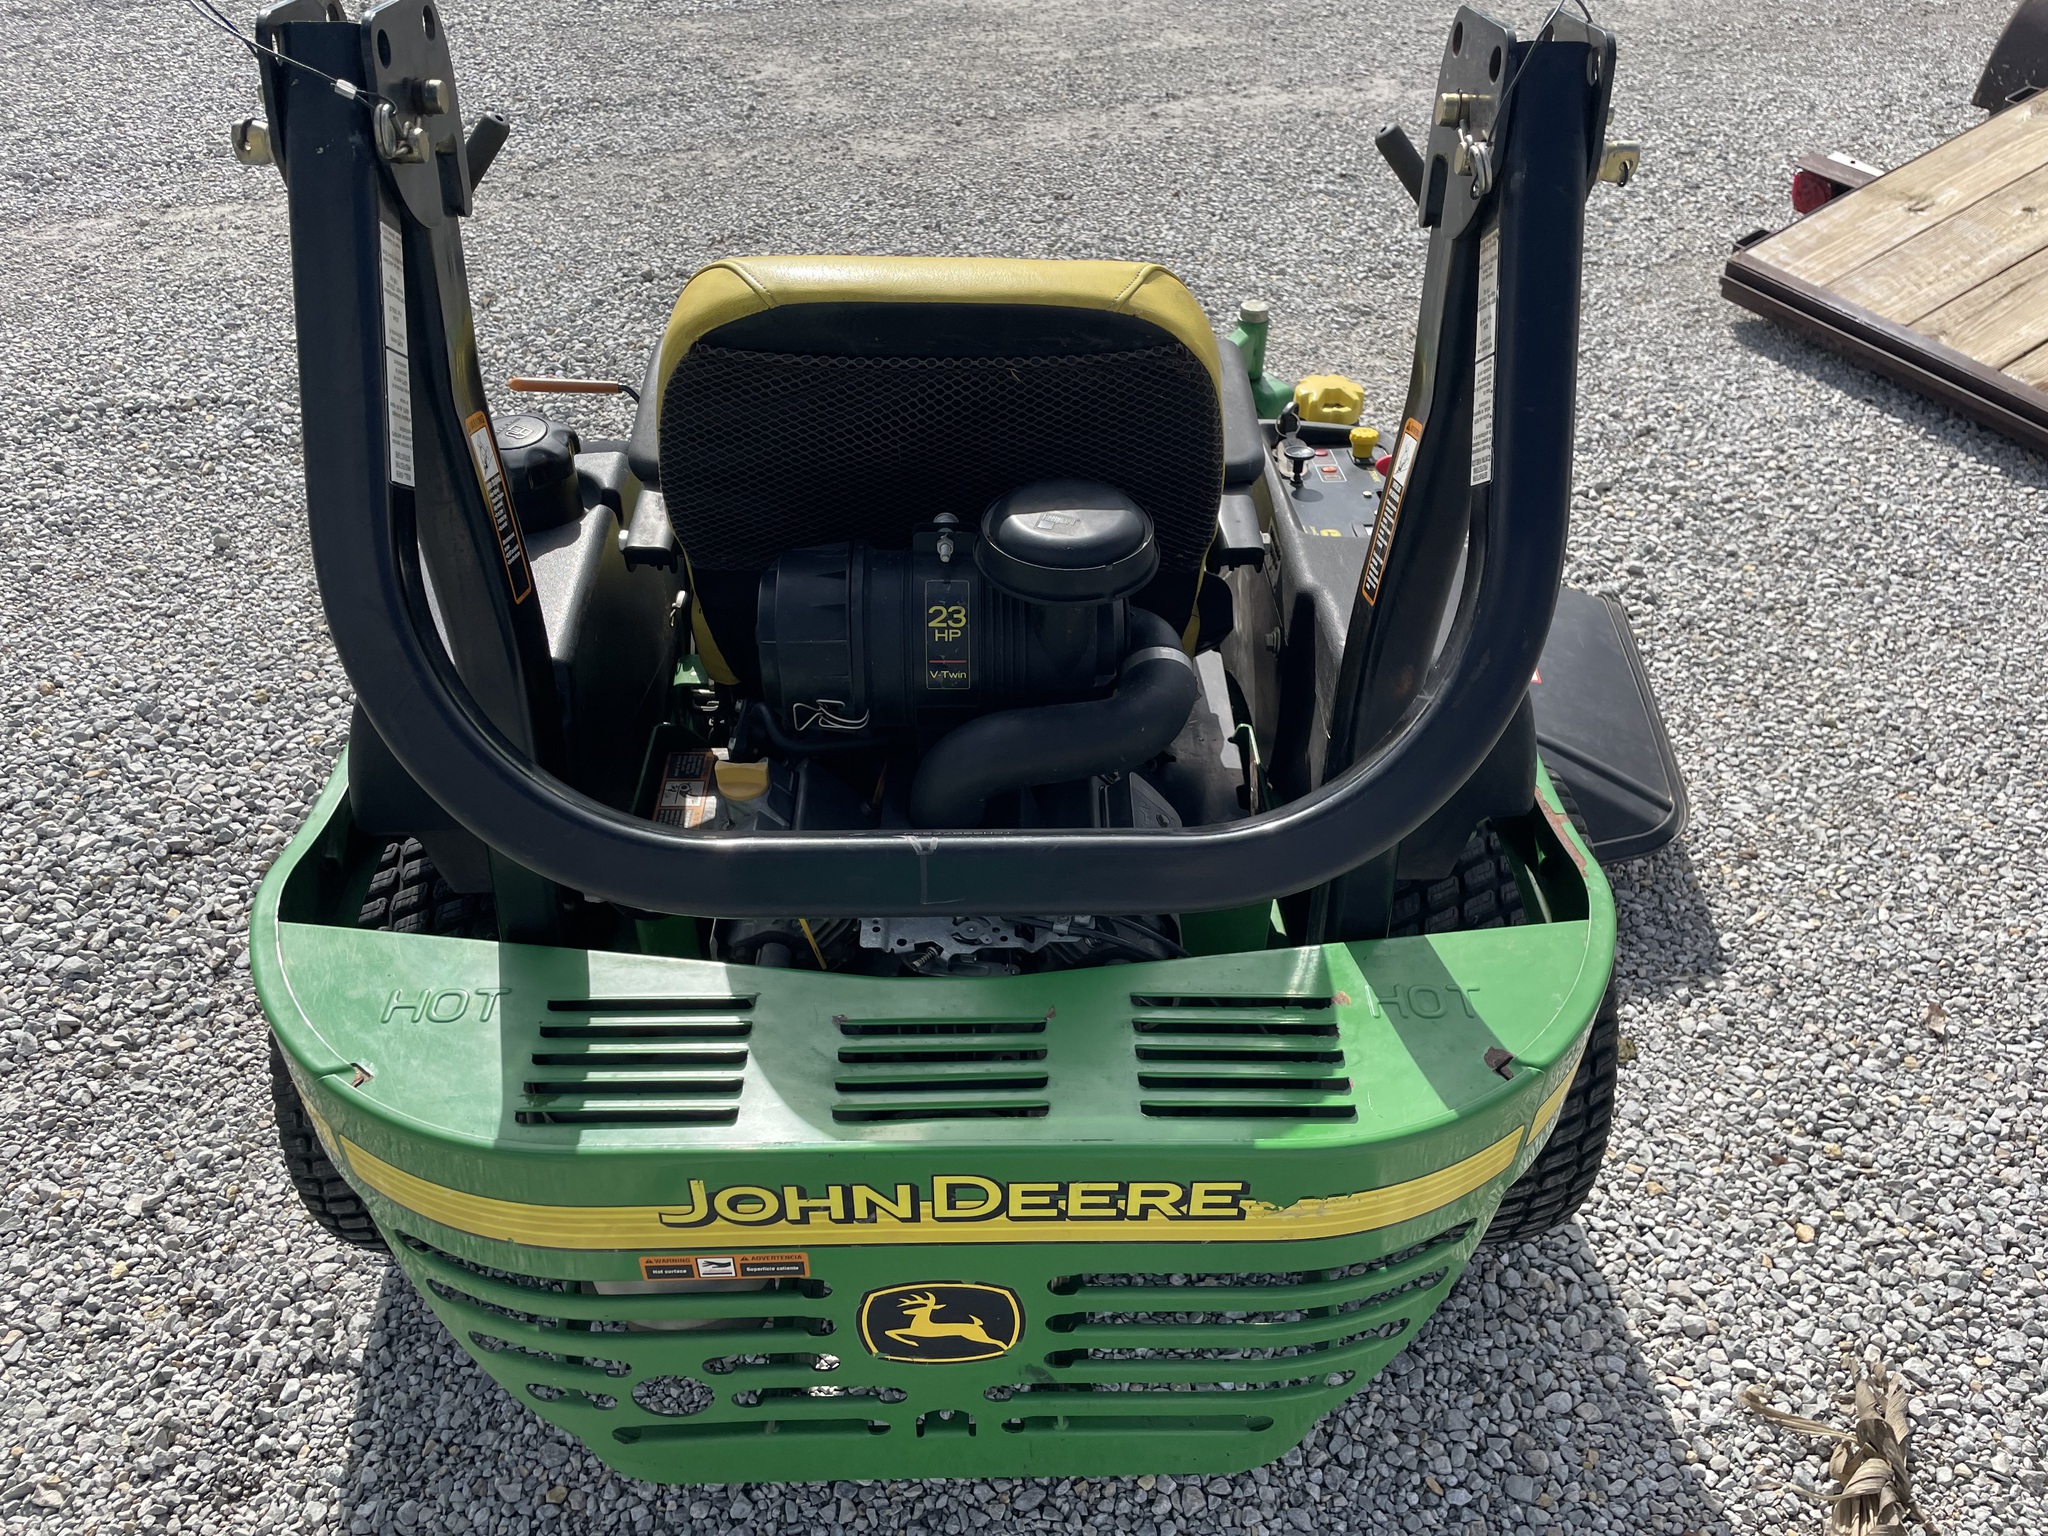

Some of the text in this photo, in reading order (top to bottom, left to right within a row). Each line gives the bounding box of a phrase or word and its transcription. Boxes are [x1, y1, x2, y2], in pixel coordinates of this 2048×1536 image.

[928, 605, 967, 628] 23
[935, 629, 962, 642] HP
[929, 670, 967, 679] V-Twin
[380, 988, 512, 1024] HOT
[1364, 984, 1480, 1019] HOT
[659, 1174, 1250, 1228] JOHN DEERE
[746, 1265, 775, 1273] Superficie
